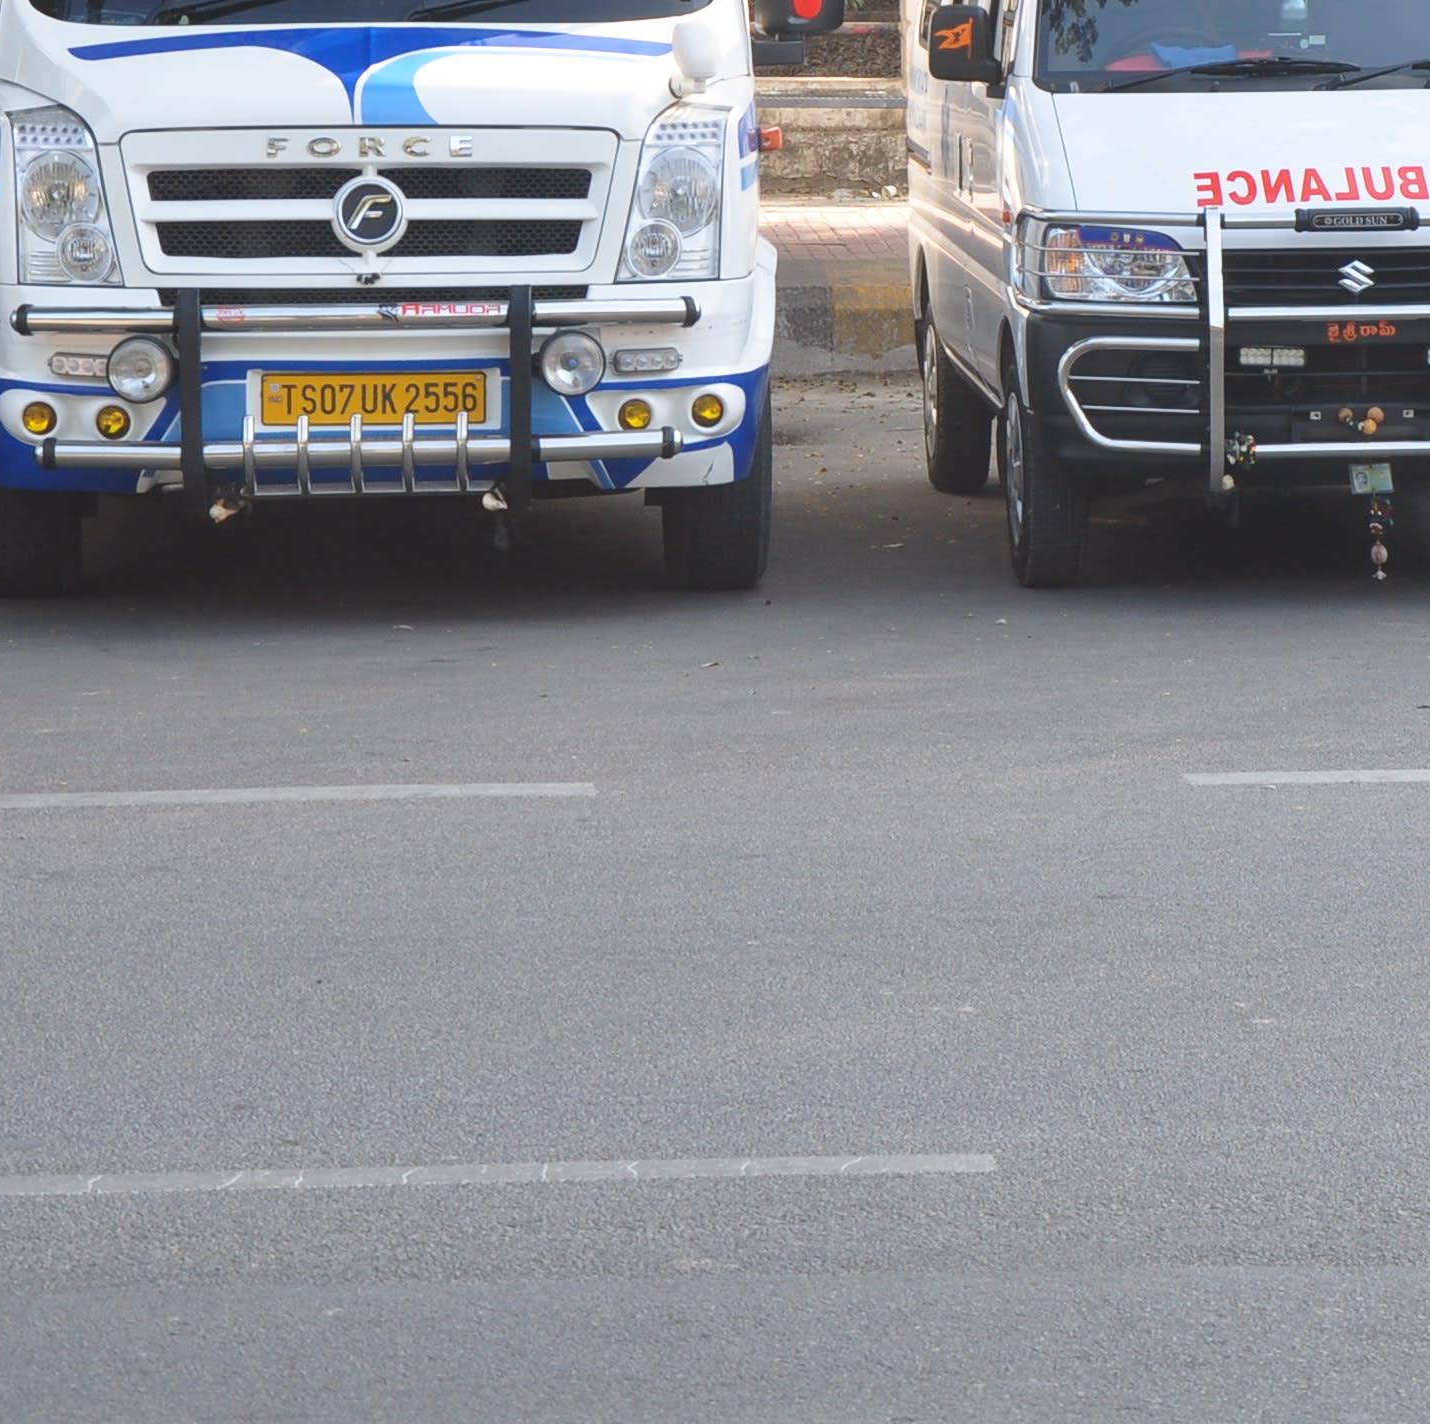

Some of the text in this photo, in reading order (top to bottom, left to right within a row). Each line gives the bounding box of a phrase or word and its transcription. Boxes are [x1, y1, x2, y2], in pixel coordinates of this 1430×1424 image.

[266, 136, 476, 158] FORCE
[1333, 215, 1388, 225] GOLD SUN
